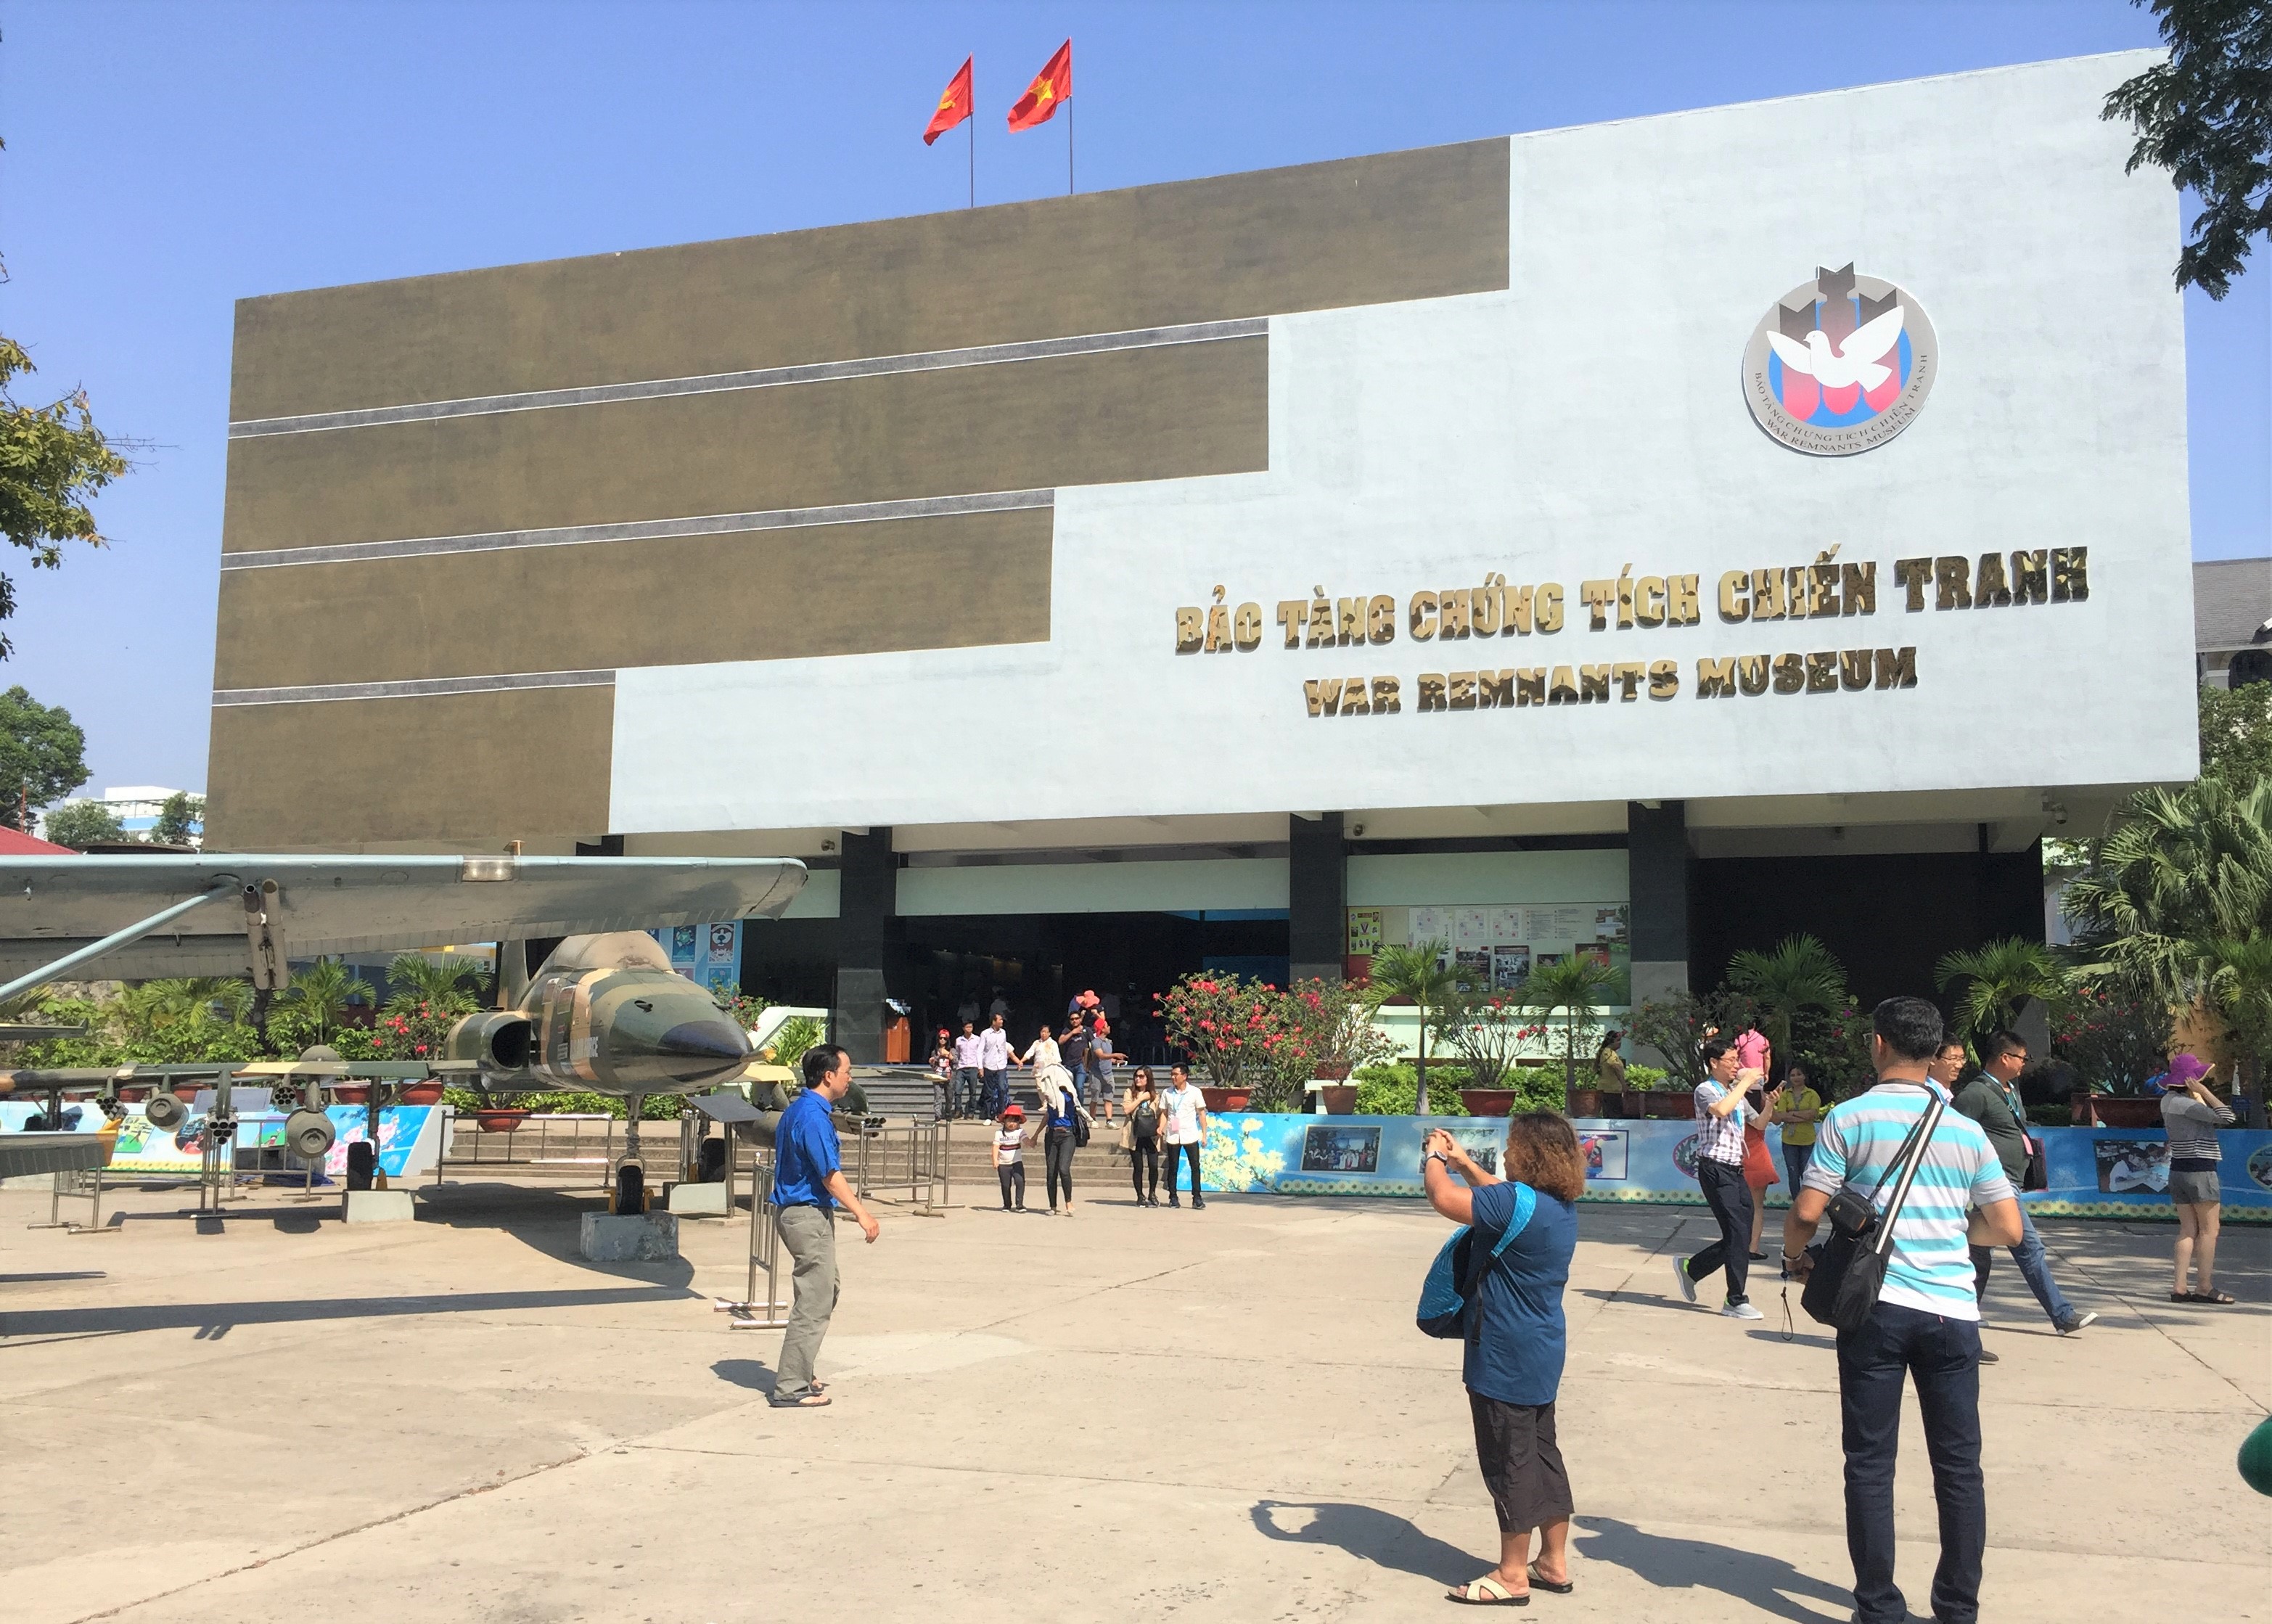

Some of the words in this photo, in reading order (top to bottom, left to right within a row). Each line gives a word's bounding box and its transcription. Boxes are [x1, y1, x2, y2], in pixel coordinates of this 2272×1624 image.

[1907, 355, 1927, 398] TRANH
[1767, 419, 1788, 439] WAR
[1791, 437, 1862, 451] REMNANTS
[1866, 407, 1916, 444] MUSEUM
[1175, 584, 1262, 655] BẢO
[1277, 585, 1395, 649] TÀNG
[1408, 572, 1564, 641] CHỨNG
[1581, 563, 1699, 631] TÍCH
[1718, 543, 1877, 625] CHIẾN
[1894, 546, 2088, 612] TRANH
[1303, 676, 1400, 717] WAR
[1417, 660, 1679, 713] REMNANTS
[1695, 647, 1917, 700] MUSEUM
